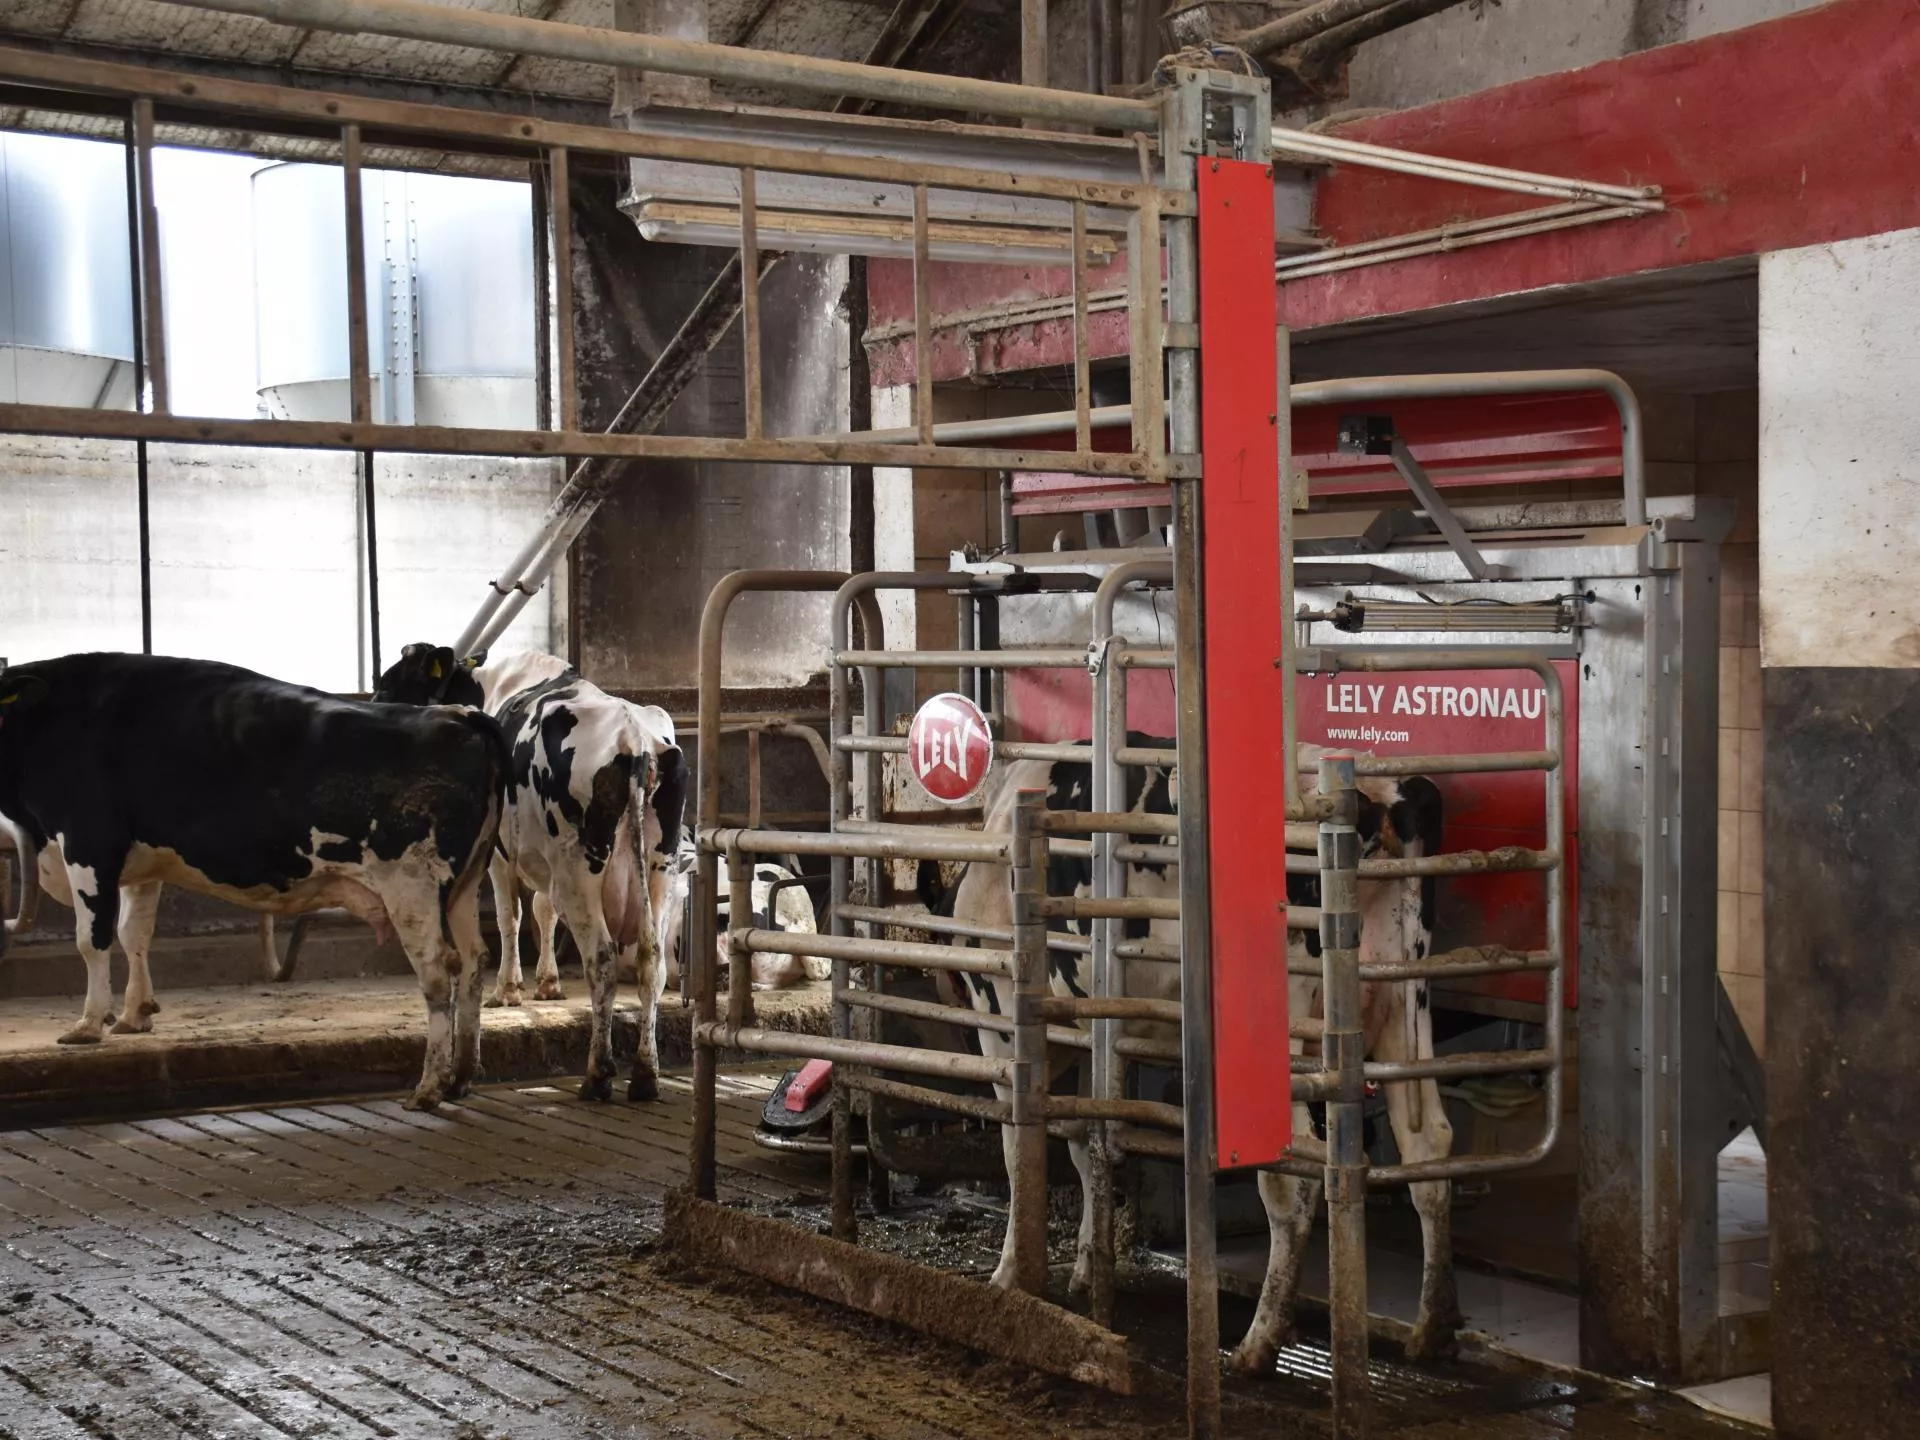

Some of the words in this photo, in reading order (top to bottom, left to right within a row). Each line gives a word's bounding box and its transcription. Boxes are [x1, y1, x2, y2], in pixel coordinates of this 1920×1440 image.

[1327, 684, 1385, 714] LELY
[1392, 685, 1546, 719] ASTRONAU
[917, 716, 974, 782] LELY
[1327, 726, 1409, 744] www.lely.com
